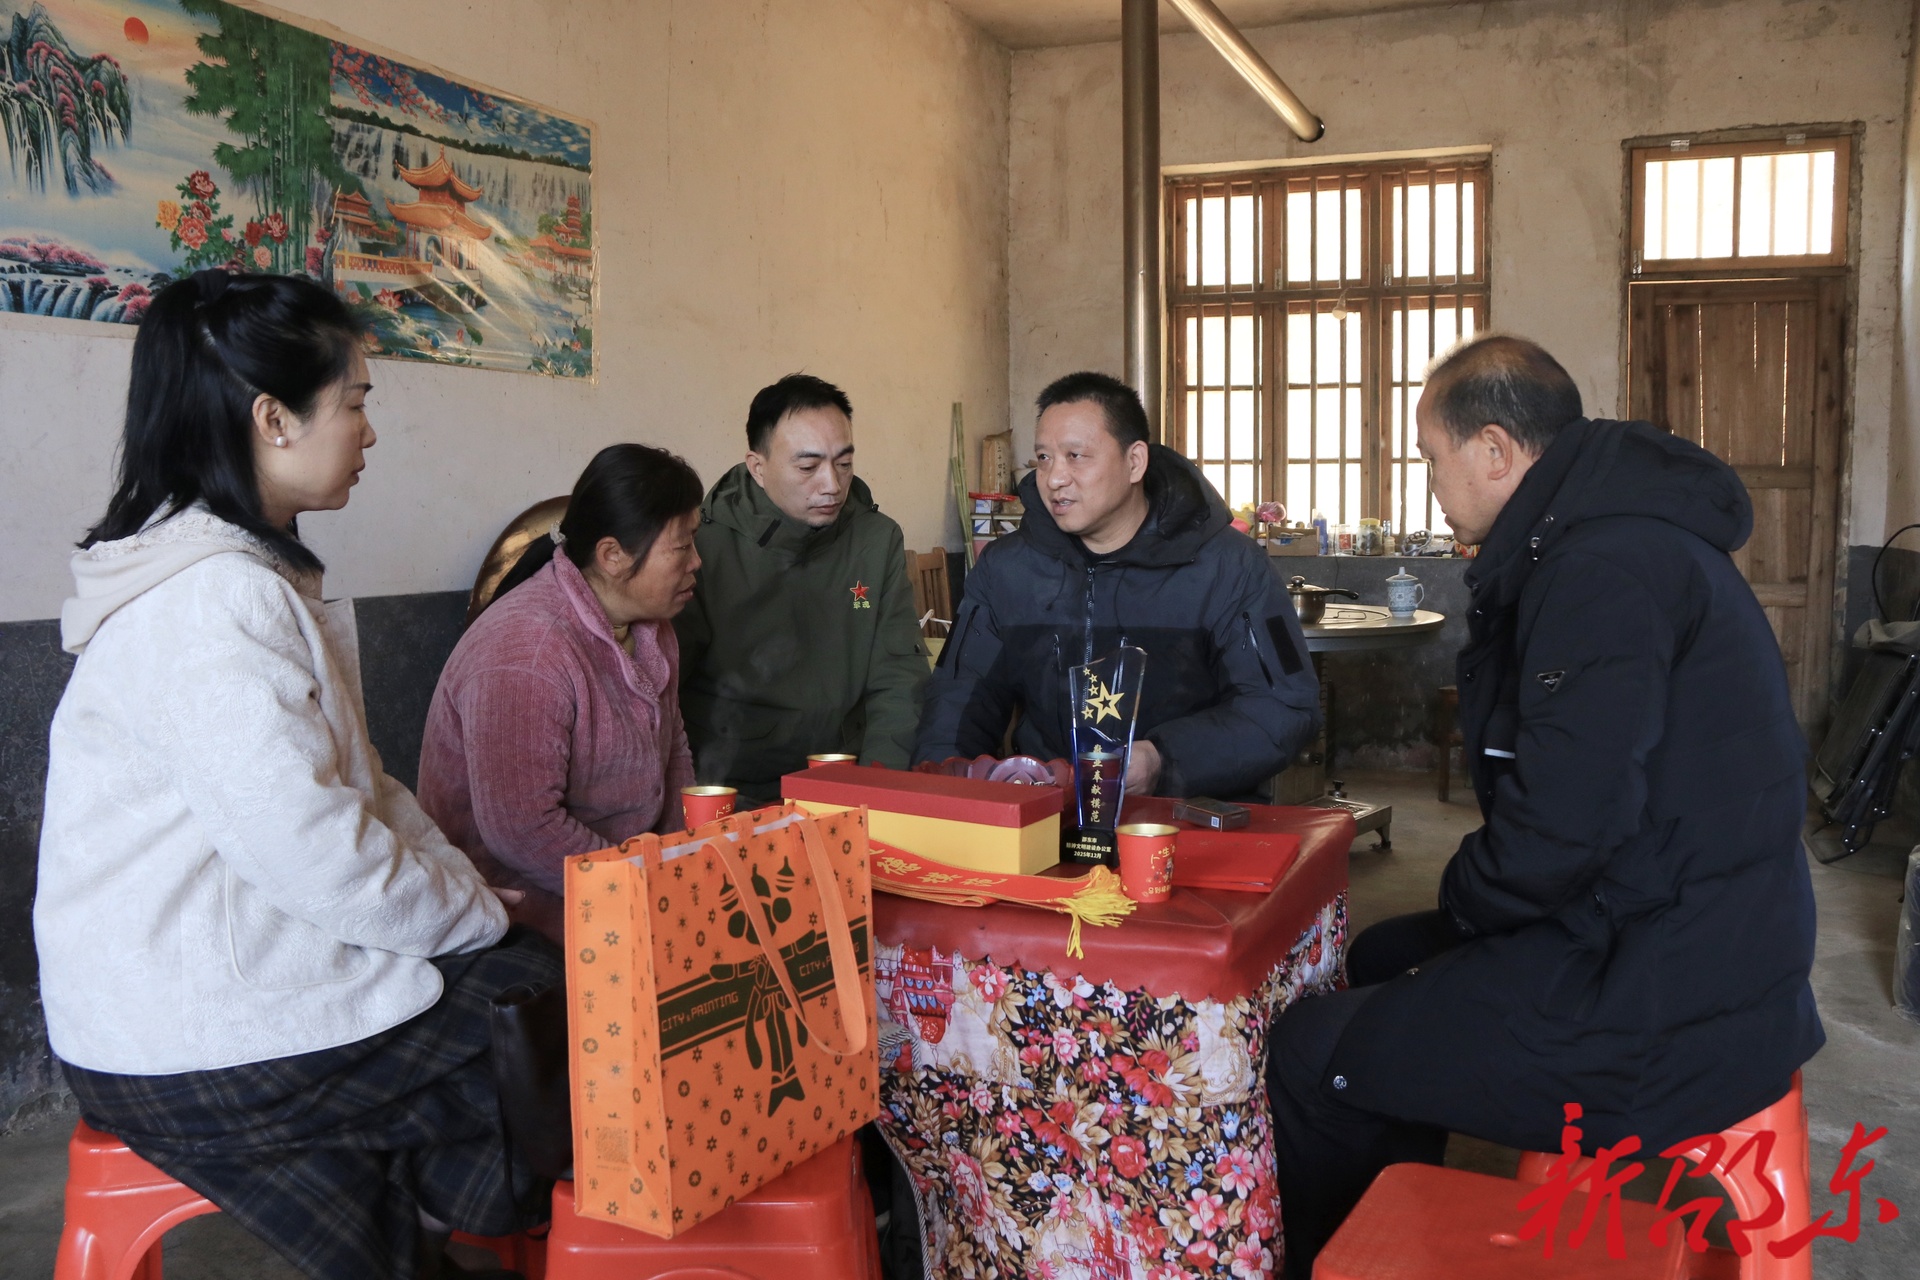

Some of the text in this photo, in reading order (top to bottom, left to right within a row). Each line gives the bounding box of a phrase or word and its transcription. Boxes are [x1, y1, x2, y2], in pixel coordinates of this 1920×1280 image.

[1091, 744, 1103, 823] 敬业奉献模范
[1081, 836, 1097, 844] 邵东市
[799, 959, 821, 977] CITY
[661, 1012, 685, 1033] CITY
[691, 991, 739, 1019] PAINTING
